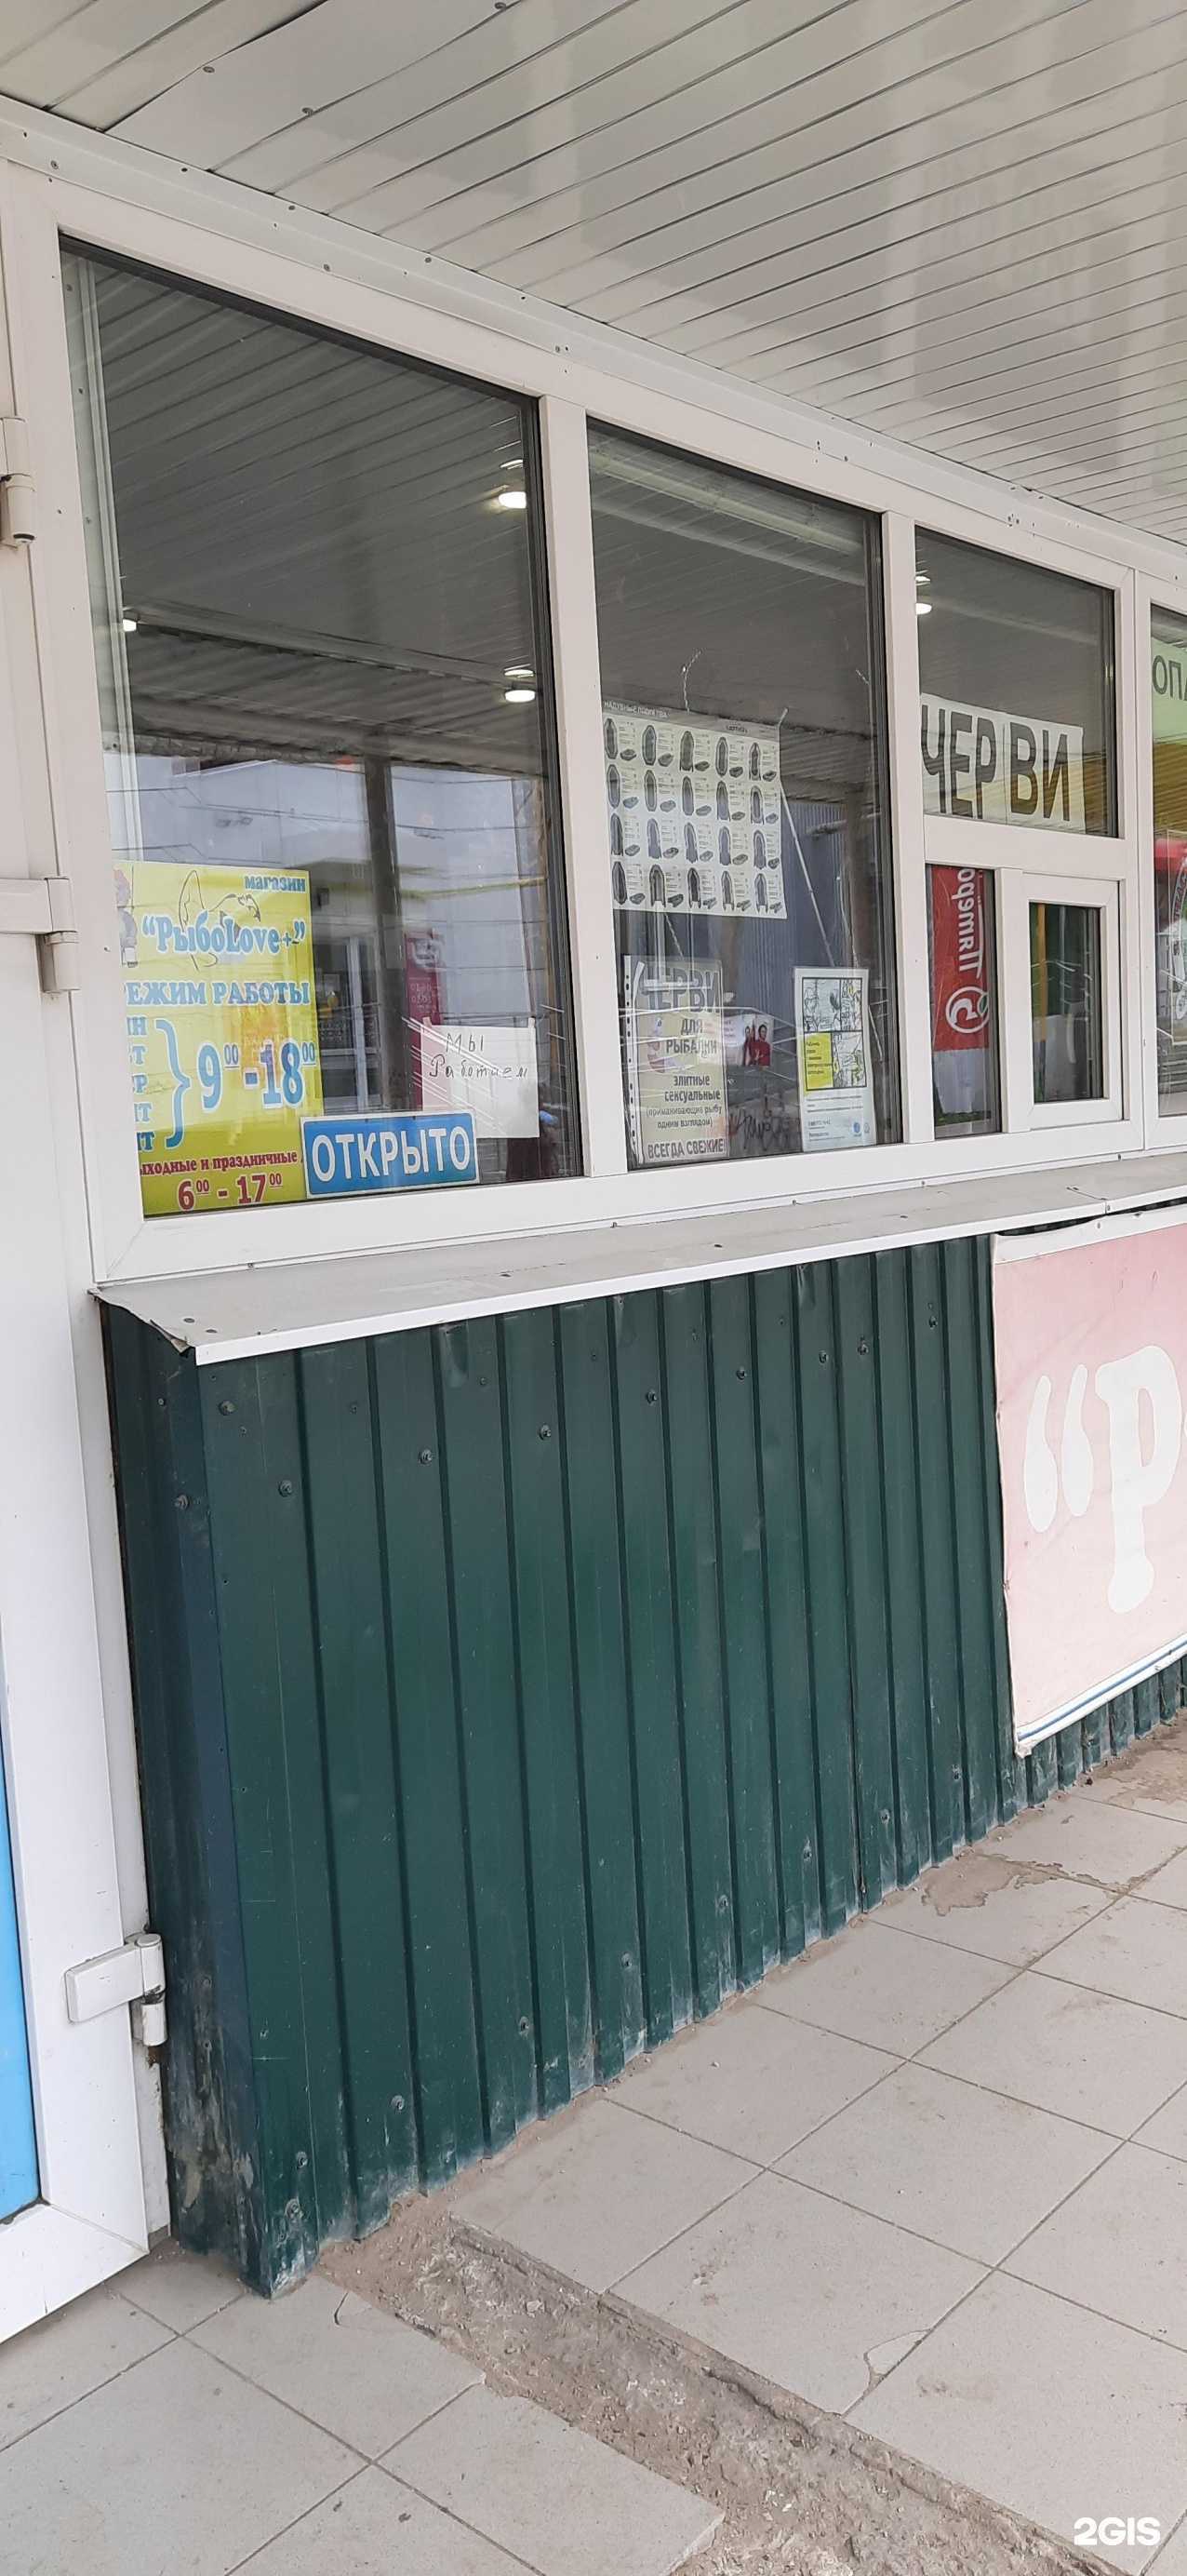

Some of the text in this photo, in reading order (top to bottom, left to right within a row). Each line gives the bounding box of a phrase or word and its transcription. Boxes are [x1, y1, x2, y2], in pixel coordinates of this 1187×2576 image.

[1153, 655, 1187, 701] ОП
[245, 876, 306, 892] магазин
[124, 982, 311, 1006] ЕЖИМ РАБОТЫ
[681, 1018, 703, 1036] ДЛЯ
[666, 1039, 717, 1054] РЫБАЛКИ
[674, 1075, 711, 1087] элитные
[664, 1089, 721, 1104] сексуальные
[312, 1125, 471, 1182] ОТКРЫТО
[647, 1141, 686, 1160] ВСЕГДА
[201, 1160, 210, 1171] и
[213, 1151, 298, 1173] праздничные
